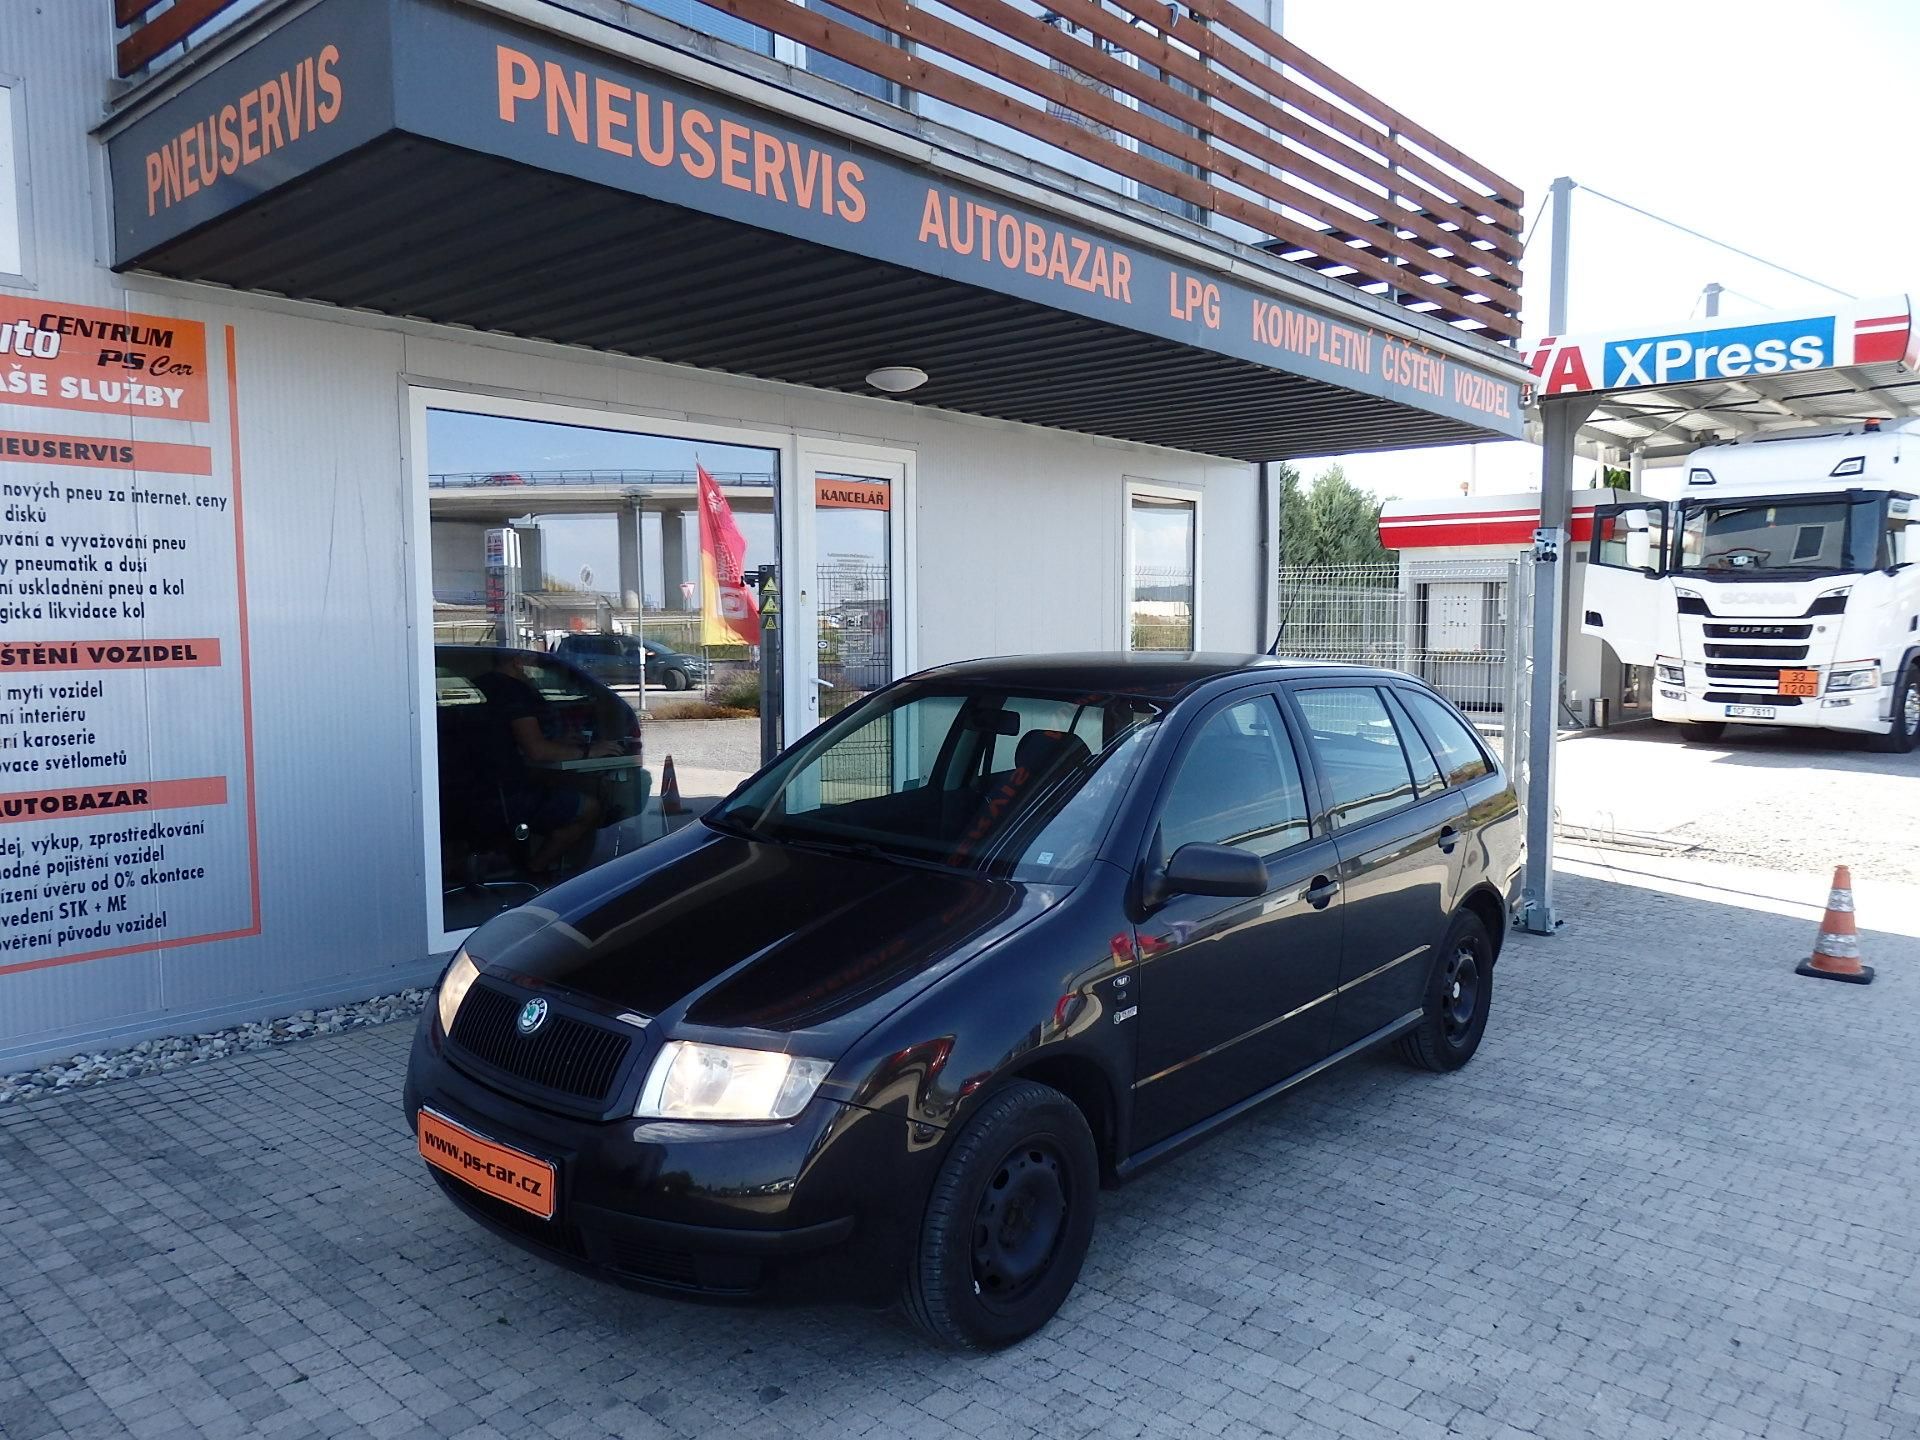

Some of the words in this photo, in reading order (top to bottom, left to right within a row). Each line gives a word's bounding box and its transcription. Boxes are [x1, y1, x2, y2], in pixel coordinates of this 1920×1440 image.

[146, 44, 342, 217] PNEUSERVIS
[496, 44, 867, 223] PNEUSERVIS
[918, 188, 1132, 304] AUTOBAZAR
[1169, 271, 1221, 330] LPG
[1252, 299, 1373, 375] KOMPLETNÍ
[1382, 331, 1447, 398] ČIŠTĚNÍ
[1453, 368, 1511, 420] VOZIDEL
[39, 313, 173, 349] CENTRUM
[96, 349, 147, 371] PS
[149, 356, 195, 377] Car
[60, 376, 185, 409] SLUŽBY
[3, 481, 60, 502] nových
[66, 487, 102, 504] pneu
[108, 489, 125, 503] za
[131, 486, 191, 507] internet.
[195, 494, 227, 512] ceny
[820, 488, 884, 506] KANCELÁŘ
[5, 504, 47, 523] disků
[45, 535, 55, 547] a
[61, 534, 147, 552] vyvažování
[152, 537, 187, 554] pneu
[15, 554, 98, 576] pneumatik
[104, 560, 112, 572] a
[119, 555, 148, 573] duší
[19, 578, 104, 595] uskladnění
[109, 582, 144, 601] pneu
[149, 583, 157, 595] a
[163, 579, 185, 596] kol
[49, 602, 118, 619] likvidace
[123, 602, 145, 619] kol
[88, 644, 198, 665] VOZIDEL
[1783, 684, 1814, 695] 1203
[1791, 672, 1806, 682] 33
[7, 684, 44, 704] mytí
[50, 680, 103, 699] vozidel
[20, 706, 86, 724] interiéru
[24, 728, 96, 748] karoserie
[45, 750, 128, 772] světlometů
[0, 788, 149, 818] UTOBAZAR
[32, 833, 83, 856] výkup,
[89, 820, 205, 847] zprostředkování
[47, 855, 109, 879] pojištění
[115, 845, 165, 867] vozidel
[43, 882, 87, 899] úvěru
[91, 873, 109, 893] od
[114, 871, 136, 889] 0%
[140, 866, 205, 886] akontace
[0, 905, 54, 928] vedení
[59, 899, 89, 920] STK
[107, 895, 128, 913] ME
[58, 920, 111, 947] původu
[116, 911, 167, 935] vozidel
[424, 1130, 543, 1197] www.ps-car.cz
